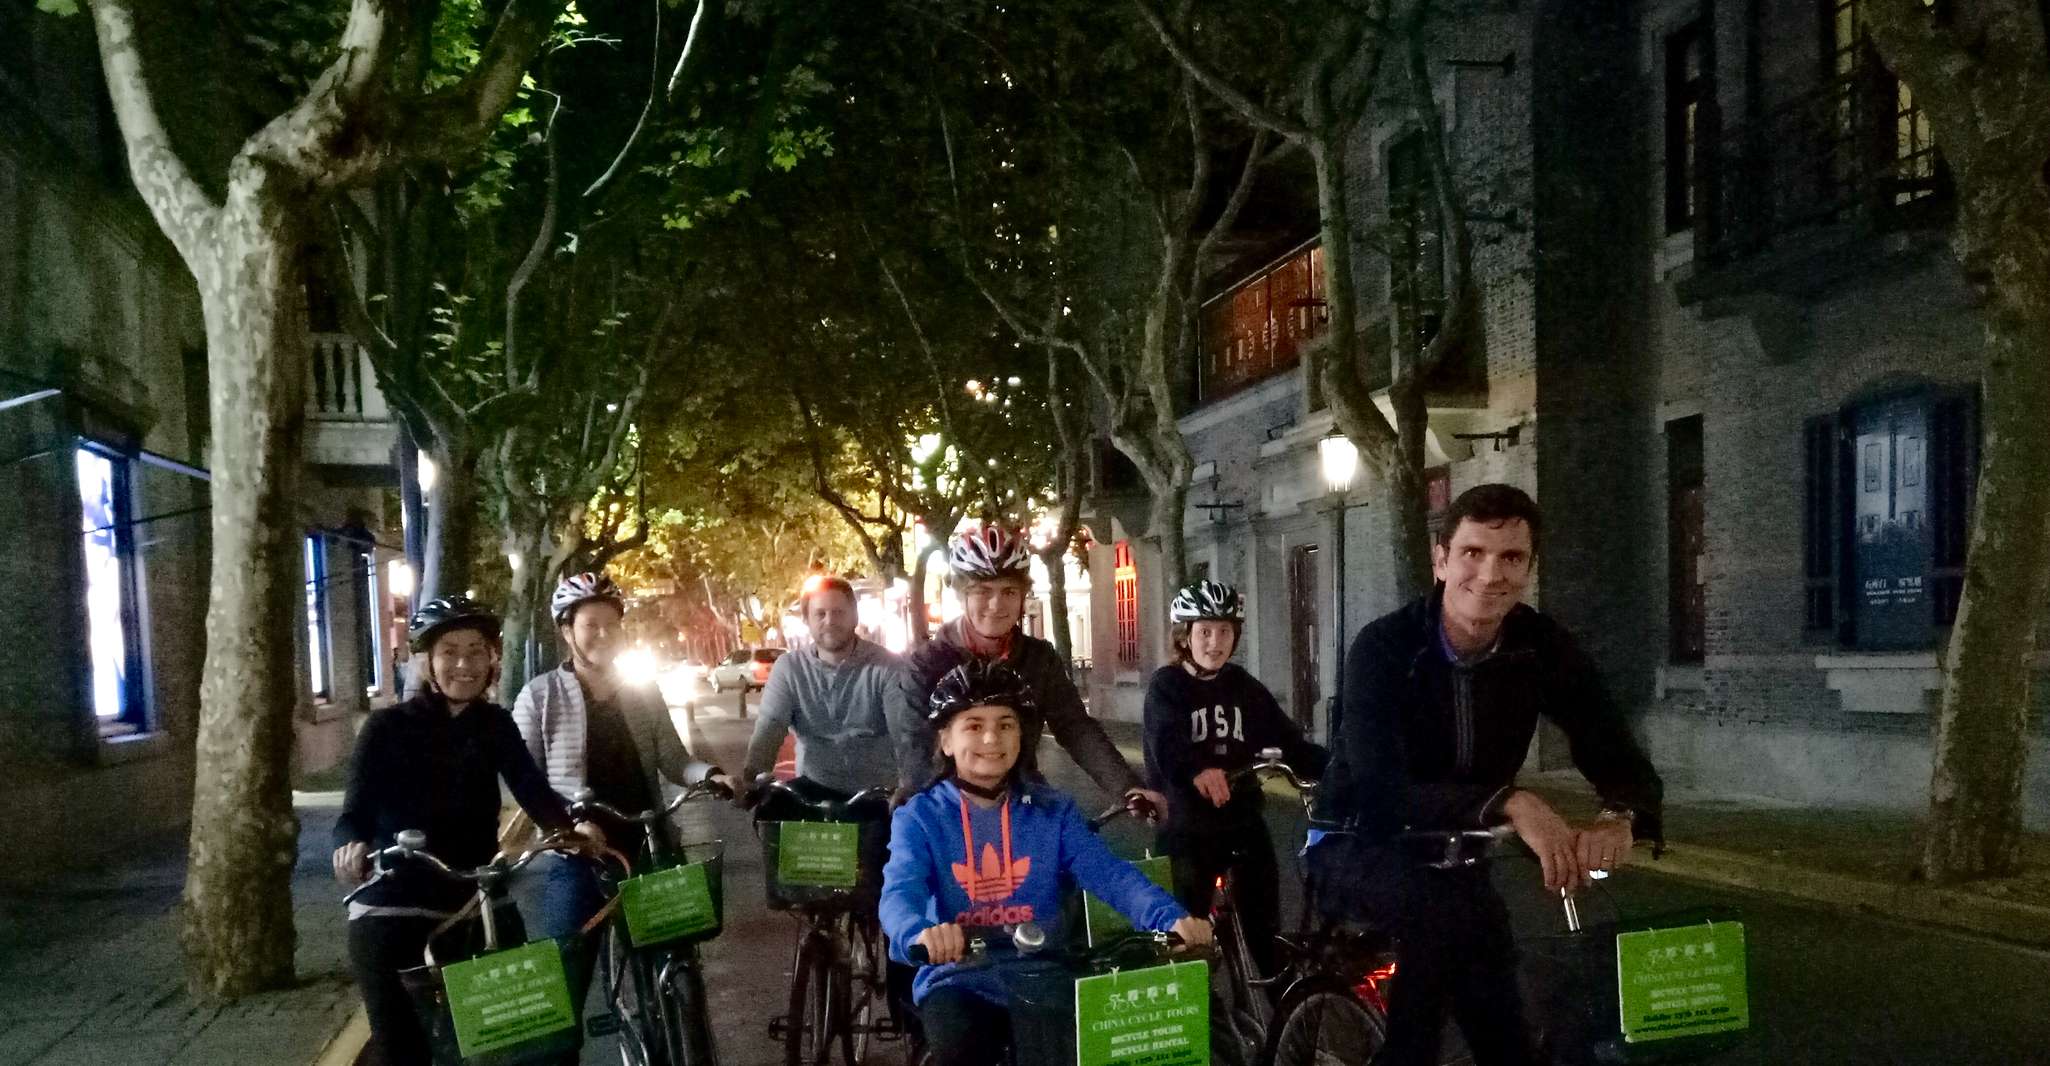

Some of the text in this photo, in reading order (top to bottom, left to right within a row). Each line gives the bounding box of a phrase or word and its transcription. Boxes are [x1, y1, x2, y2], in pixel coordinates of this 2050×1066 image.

[1191, 704, 1244, 742] USA
[956, 905, 1033, 926] adidas
[1092, 1006, 1200, 1032] CHINA CYCLE TOURS
[1111, 1025, 1183, 1044] BICYCLE TOURS
[1111, 1037, 1189, 1058] BICYCLE RENTAL
